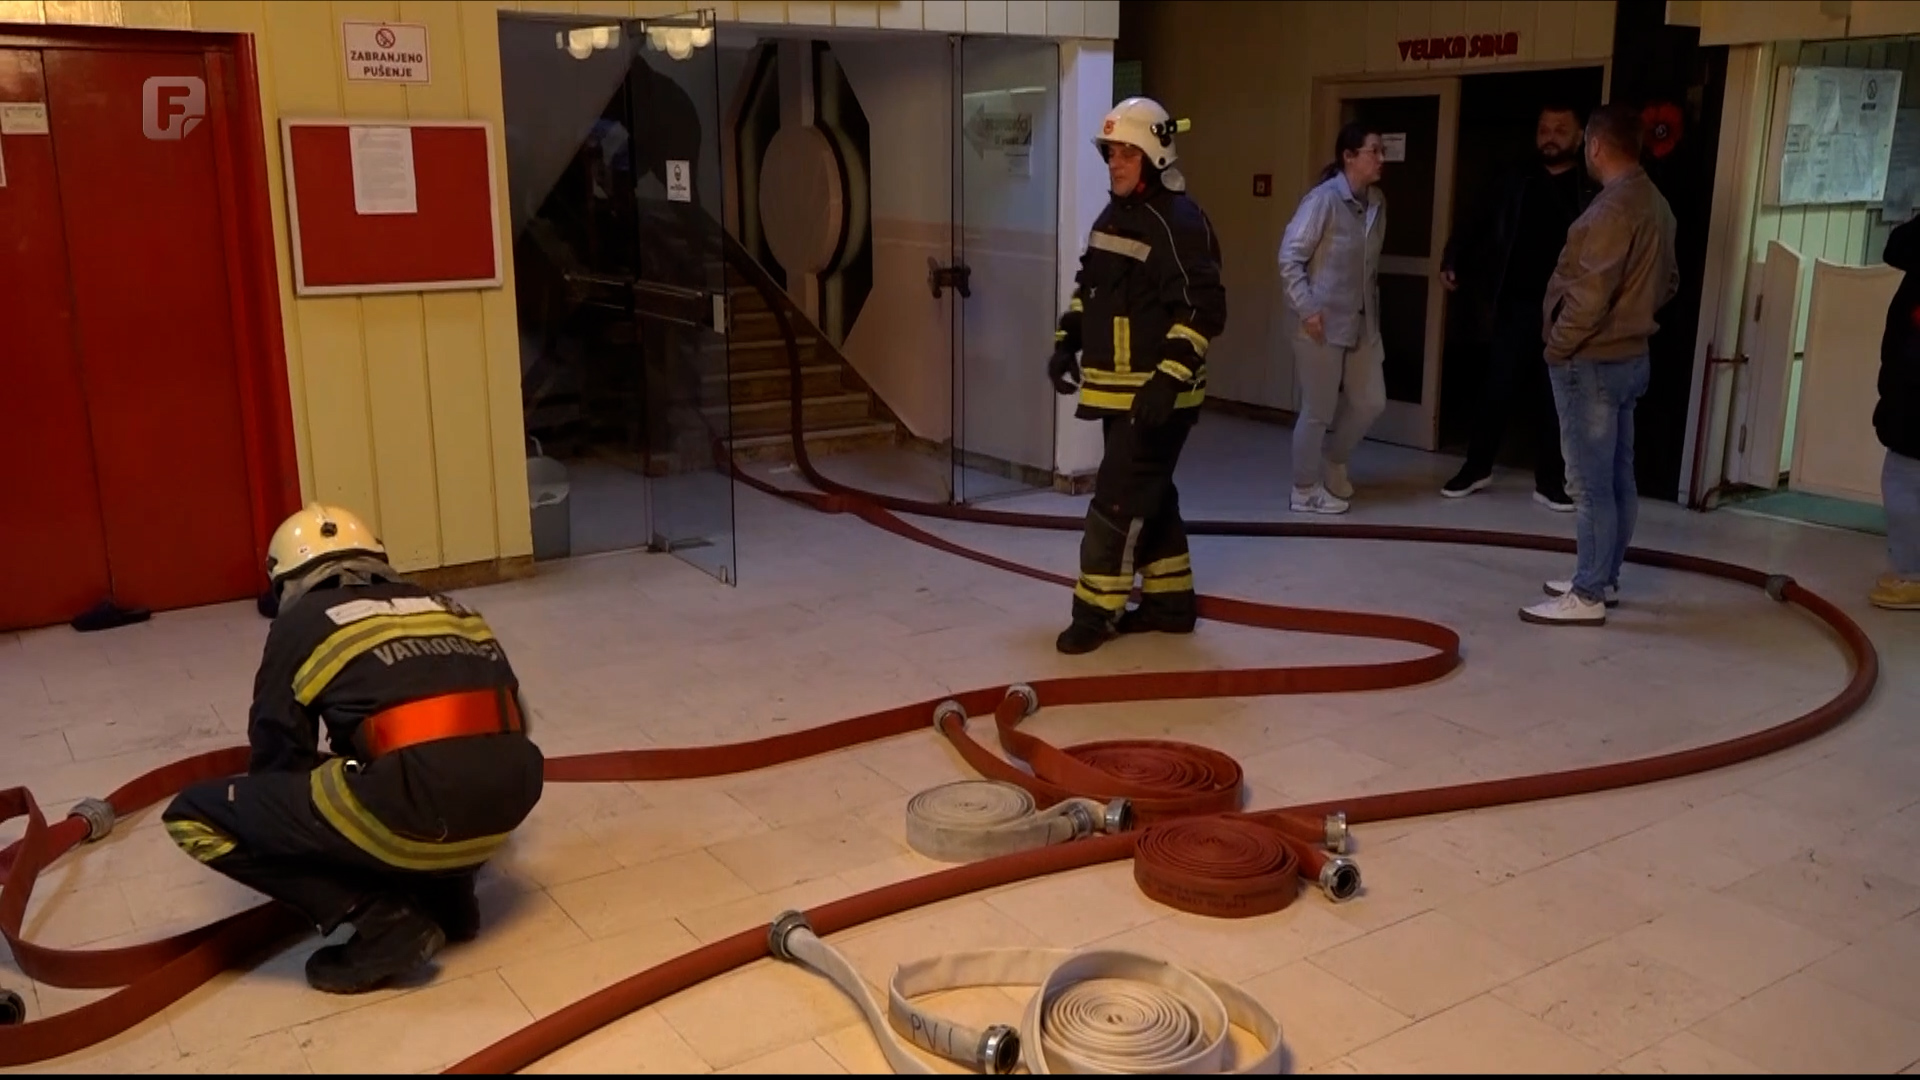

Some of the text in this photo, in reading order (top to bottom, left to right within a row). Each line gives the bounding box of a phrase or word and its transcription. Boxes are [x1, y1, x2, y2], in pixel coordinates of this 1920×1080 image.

[1398, 32, 1518, 62] VELIKA SALA
[351, 50, 423, 63] ZABRANJENO
[363, 64, 412, 77] PUŠENJE
